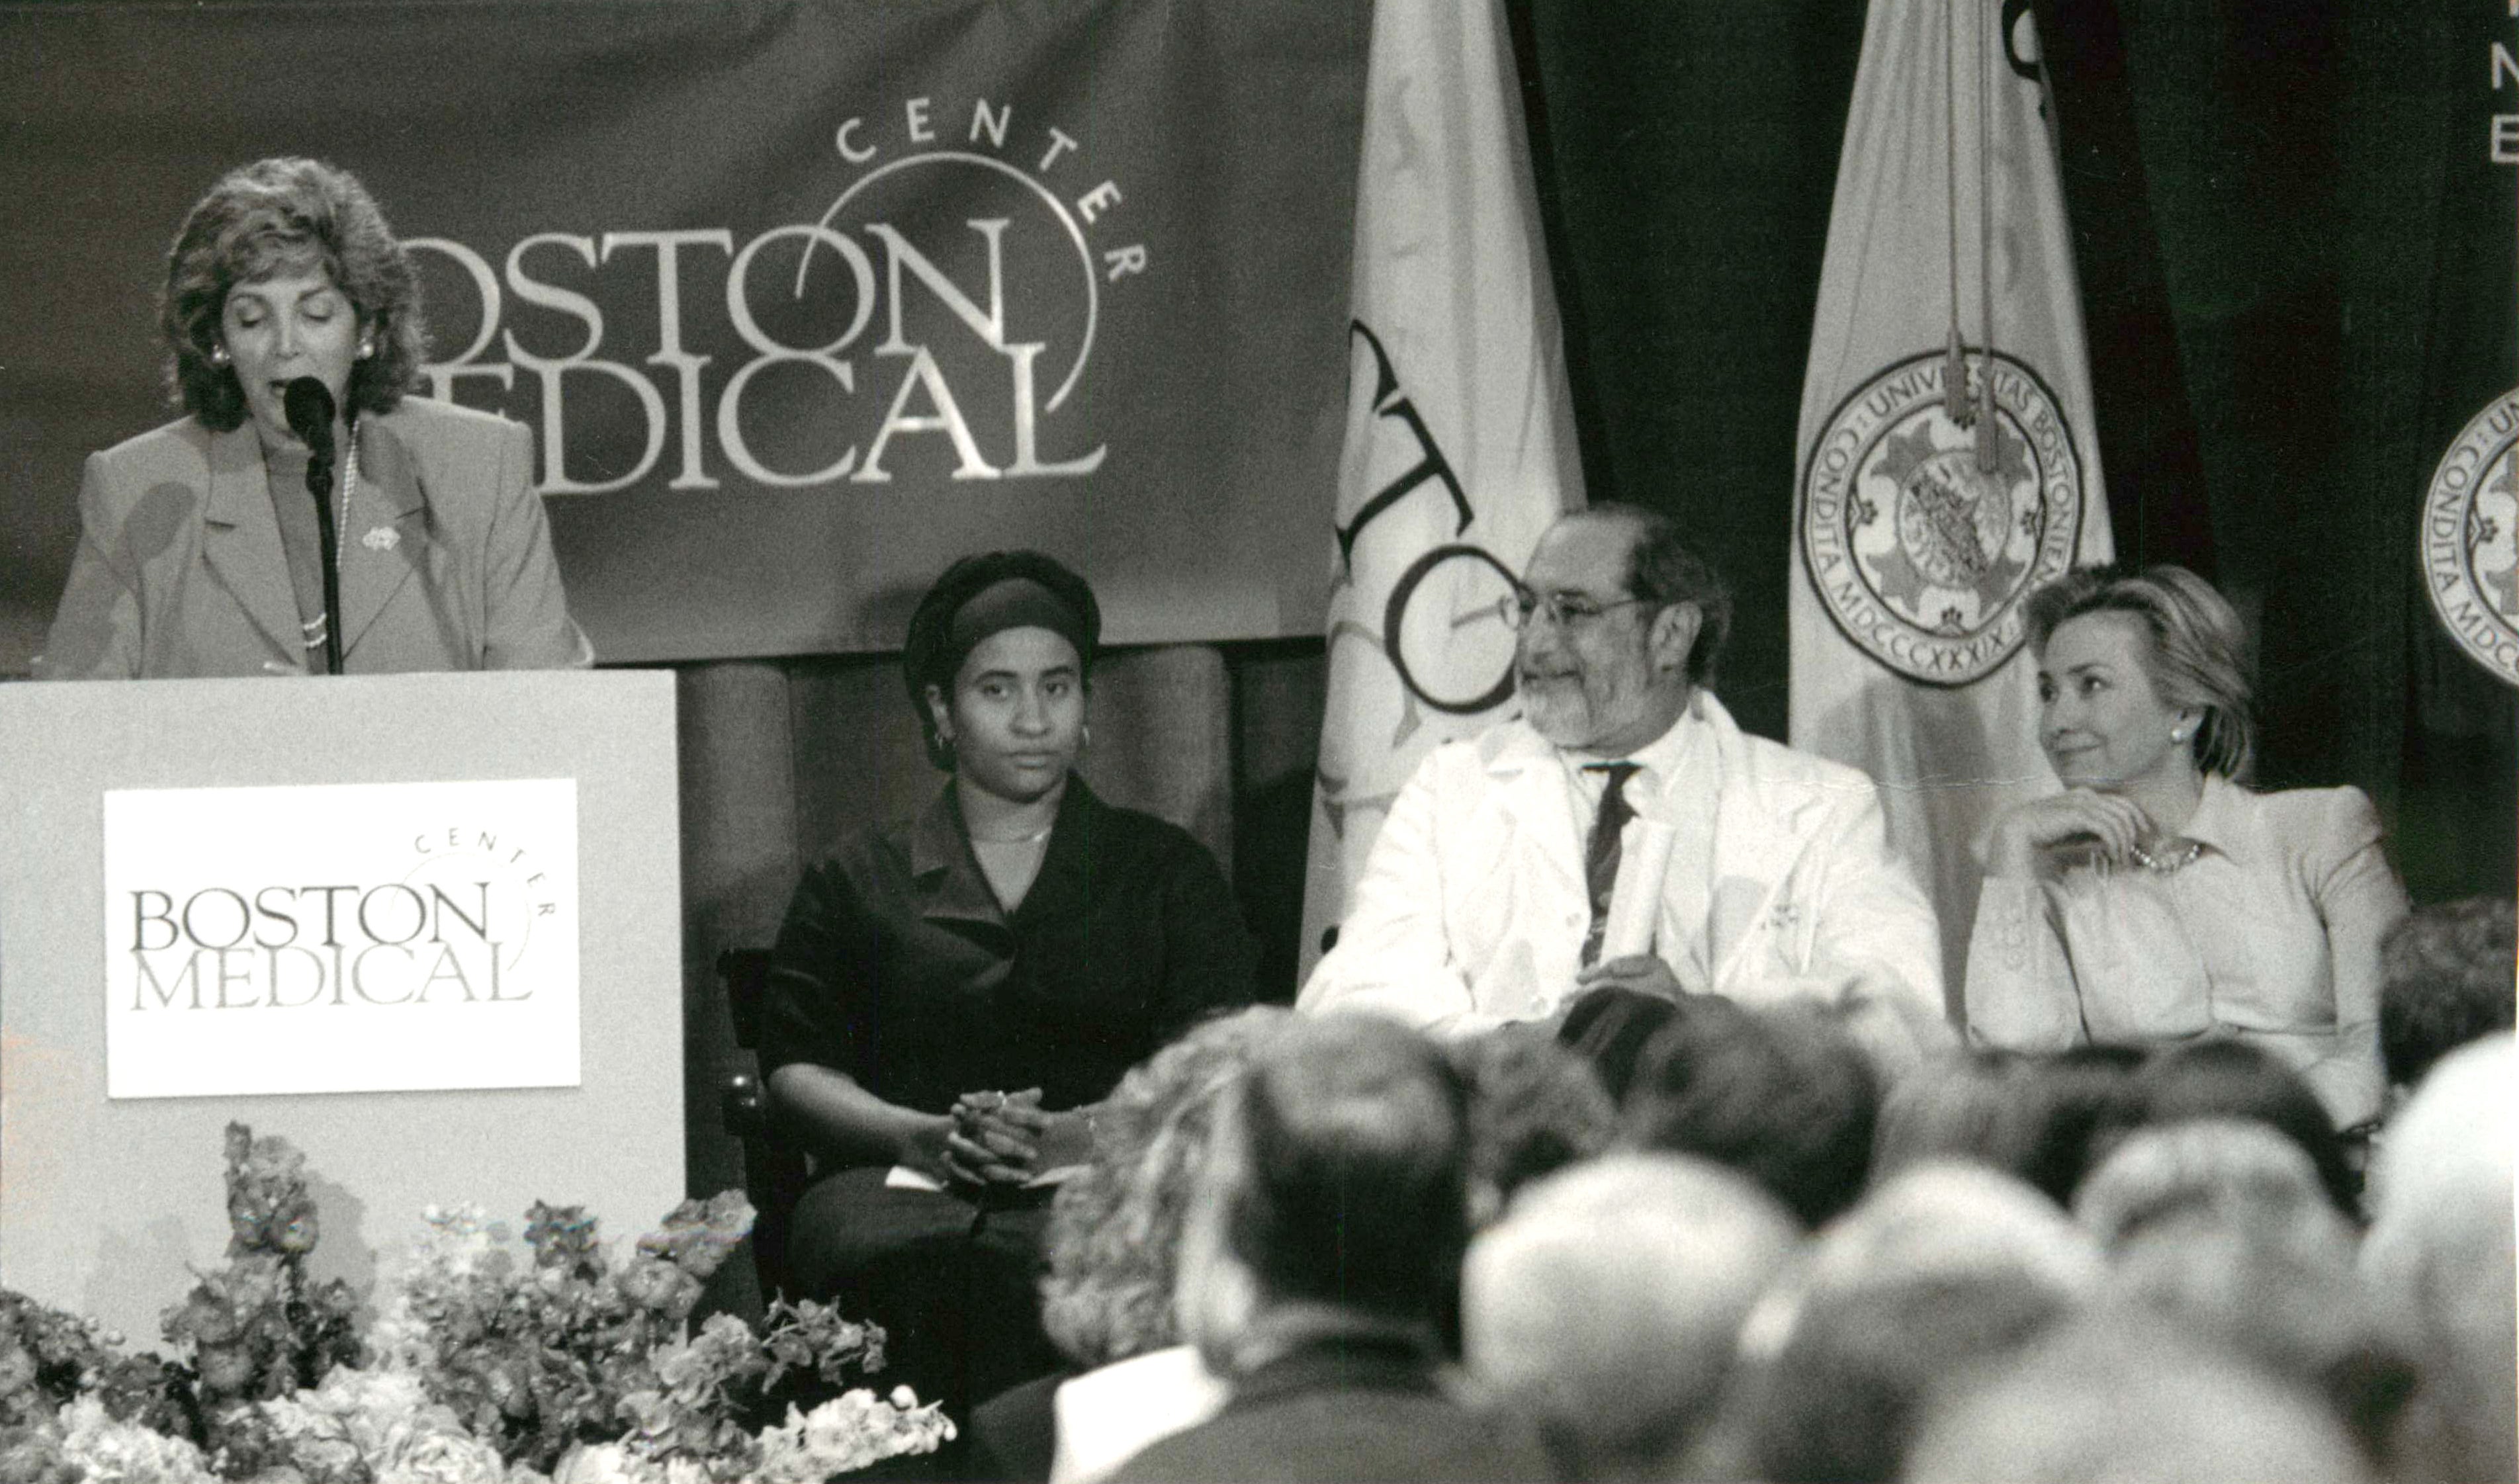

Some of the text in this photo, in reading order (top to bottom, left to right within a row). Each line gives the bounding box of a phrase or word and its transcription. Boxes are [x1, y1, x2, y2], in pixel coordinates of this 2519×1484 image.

[836, 97, 1147, 282] CENTER
[395, 219, 1010, 374] OSTON
[418, 342, 1107, 494] DICAL
[1816, 428, 1859, 574] CONDITA
[2432, 445, 2479, 592] CONDITA
[130, 881, 490, 951] BOSTON
[414, 827, 556, 917] CENTER
[130, 941, 533, 1010] MEDICAL
